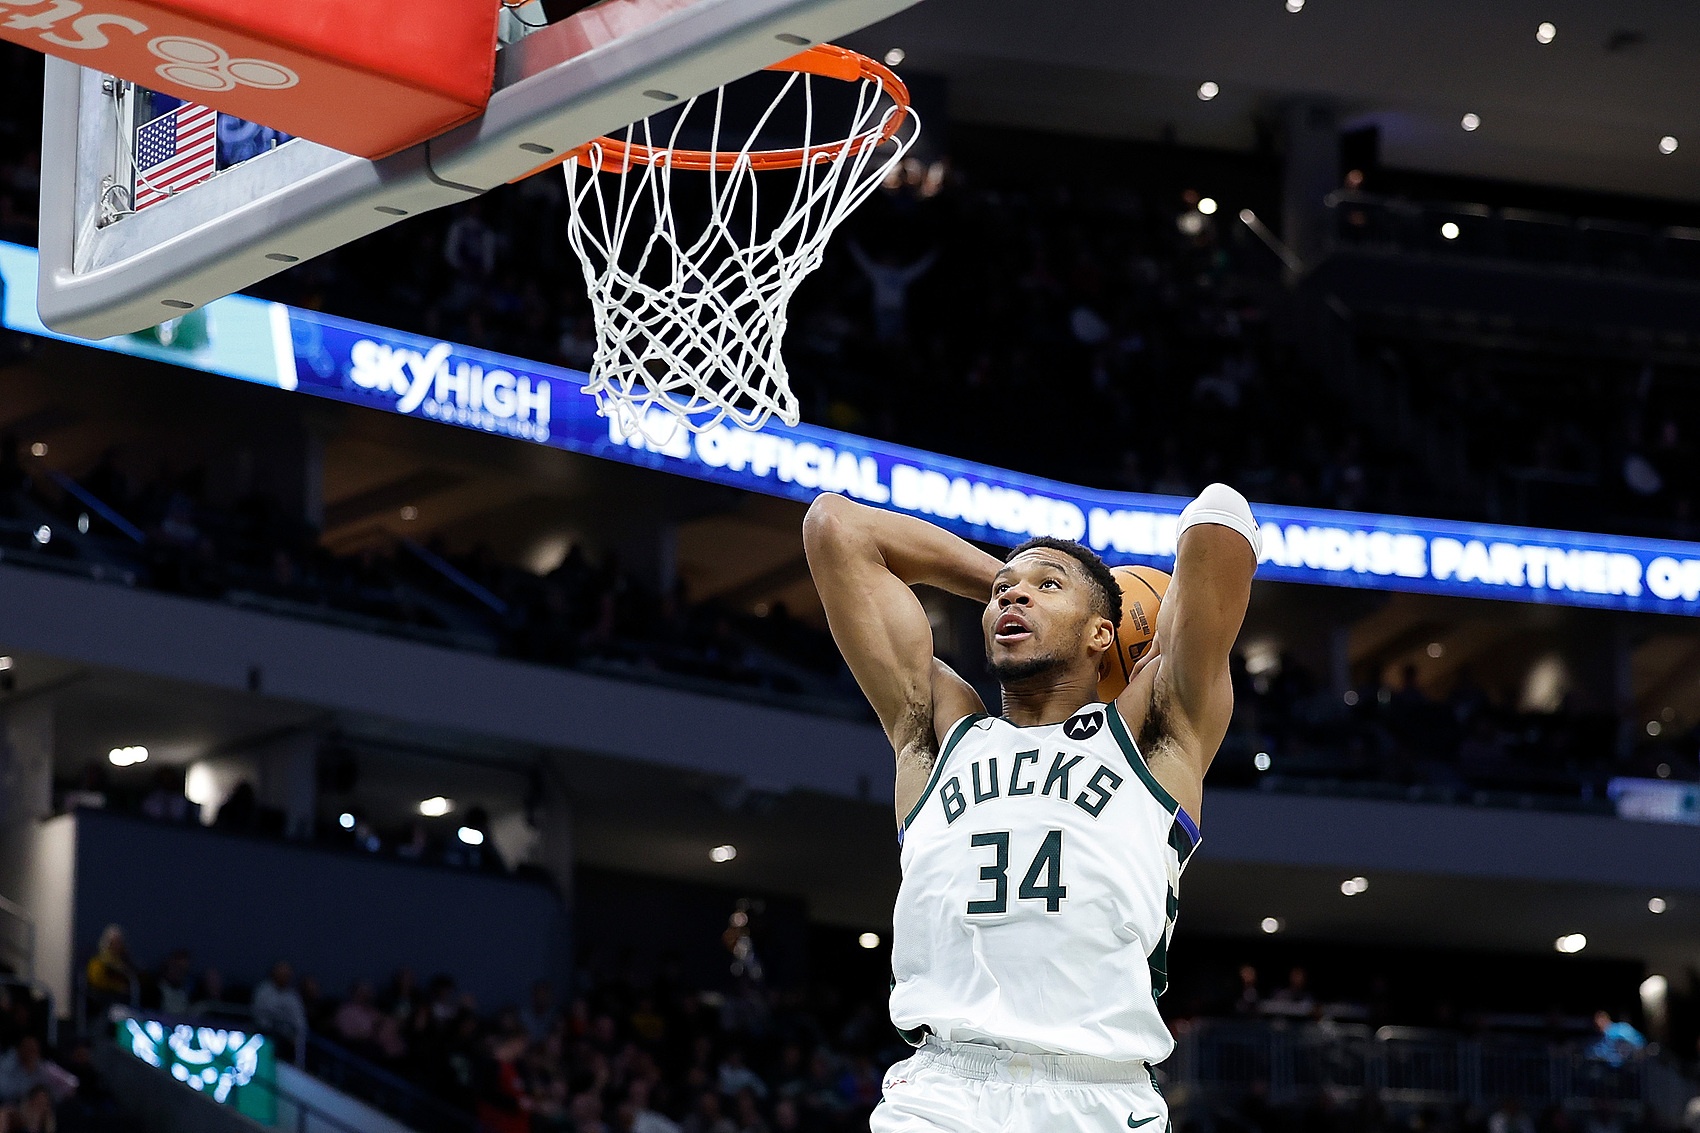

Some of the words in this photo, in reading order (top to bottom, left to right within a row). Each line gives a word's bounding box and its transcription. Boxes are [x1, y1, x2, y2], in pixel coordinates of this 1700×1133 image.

[0, 0, 147, 49] St
[604, 400, 691, 459] THE
[695, 422, 890, 504] OFFICIAL
[891, 464, 1085, 542] BRANDED
[1088, 507, 1427, 578] MERANDISE
[1431, 537, 1643, 597] PARTNER
[939, 749, 1124, 825] BUCKS
[966, 829, 1067, 915] 34
